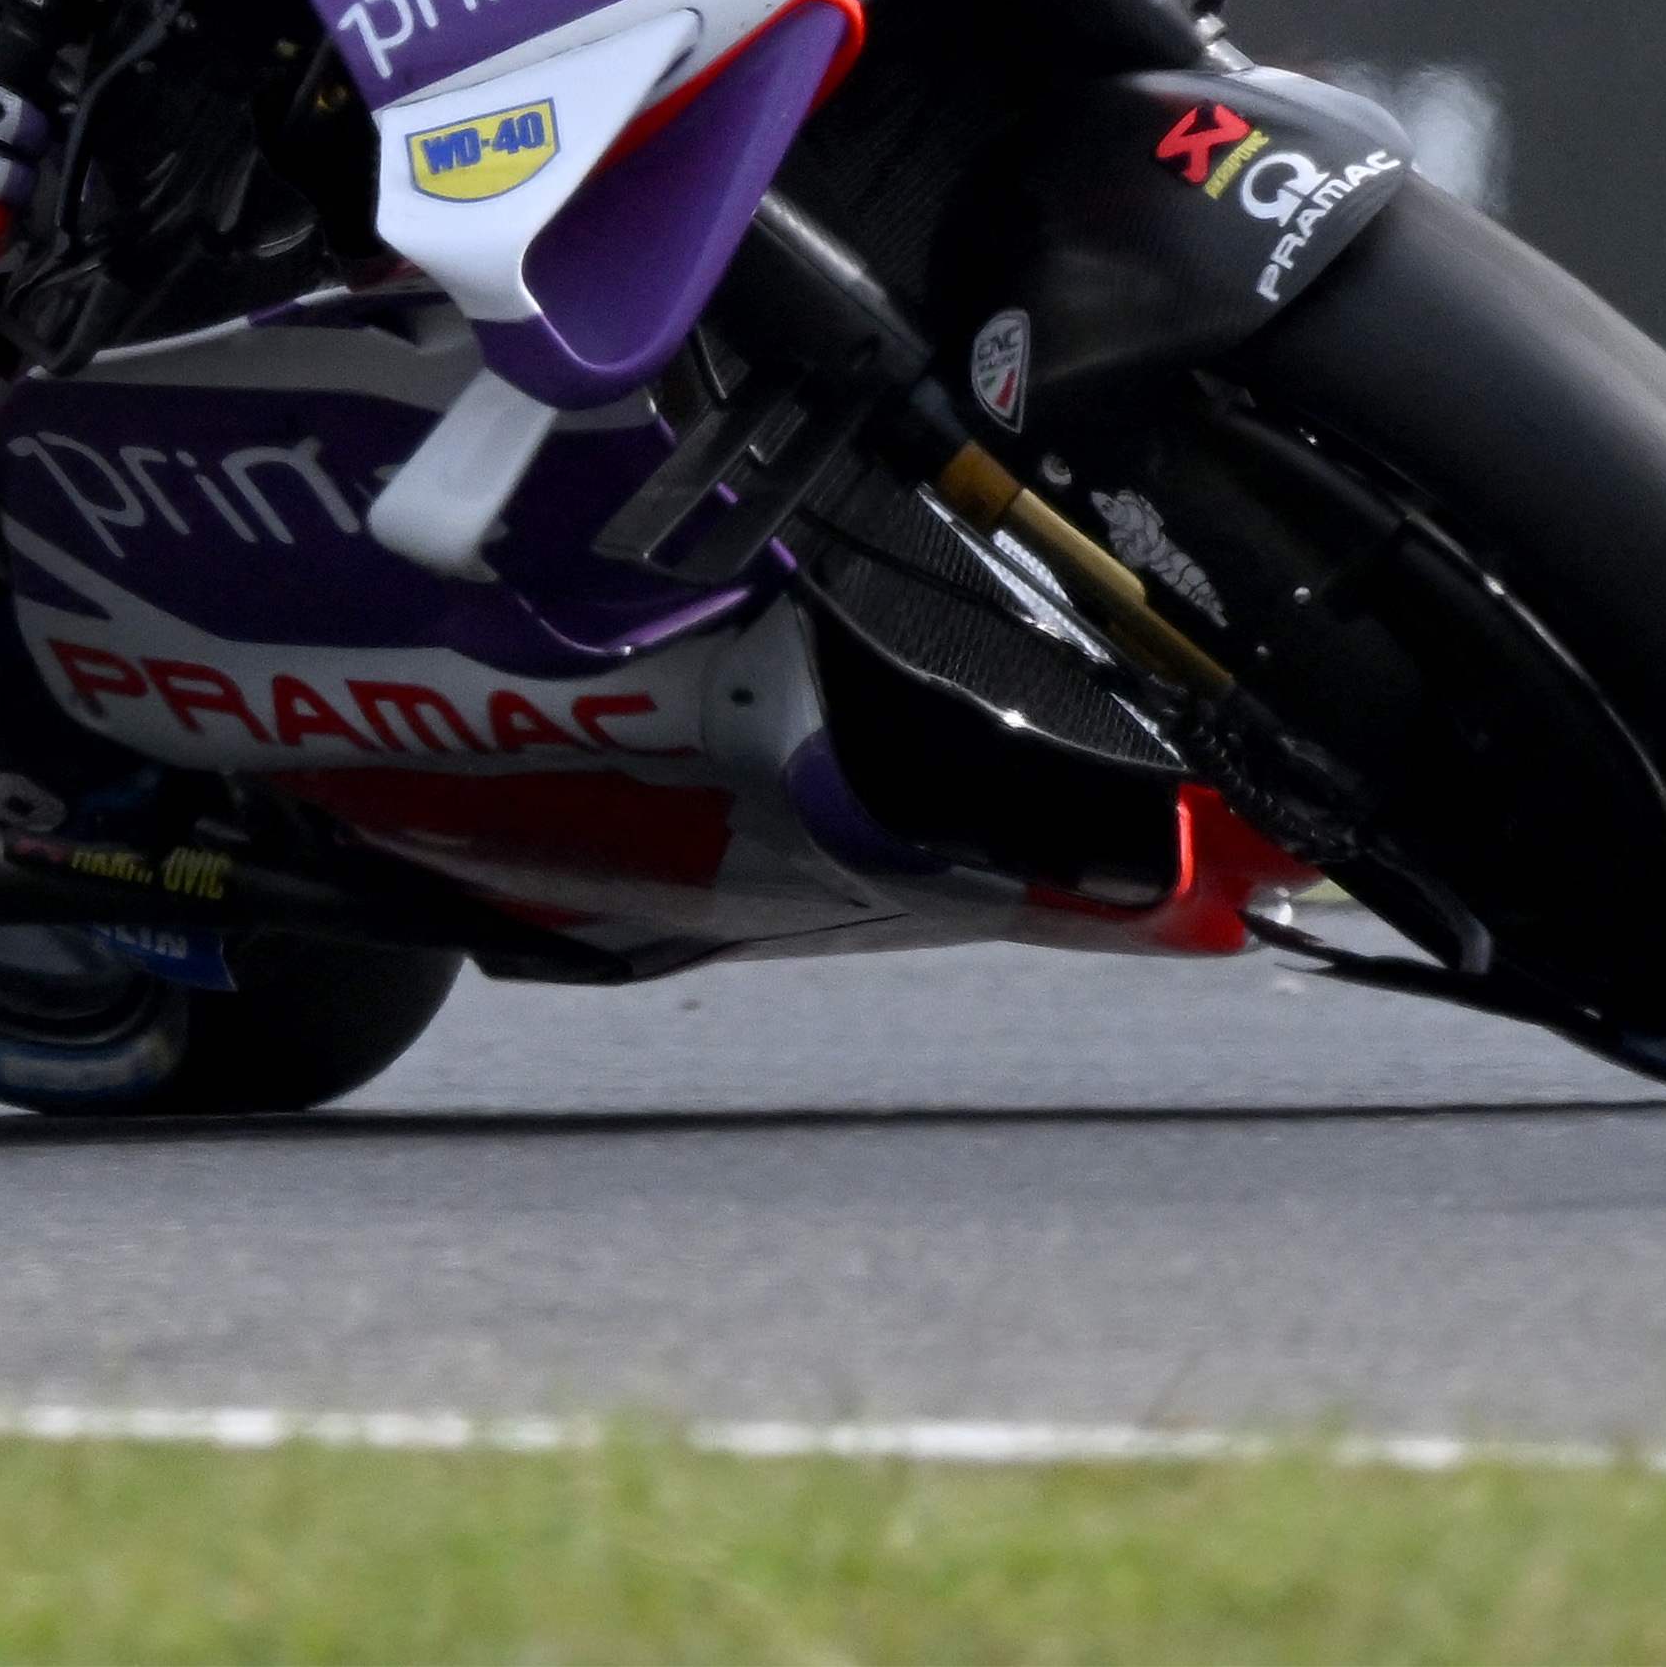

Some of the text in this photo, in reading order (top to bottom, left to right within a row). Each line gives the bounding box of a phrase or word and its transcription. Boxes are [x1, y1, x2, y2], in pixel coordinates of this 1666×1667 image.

[421, 111, 545, 176] WD-40
[1255, 149, 1401, 303] PRAMAC
[49, 638, 703, 759] PRAMAC
